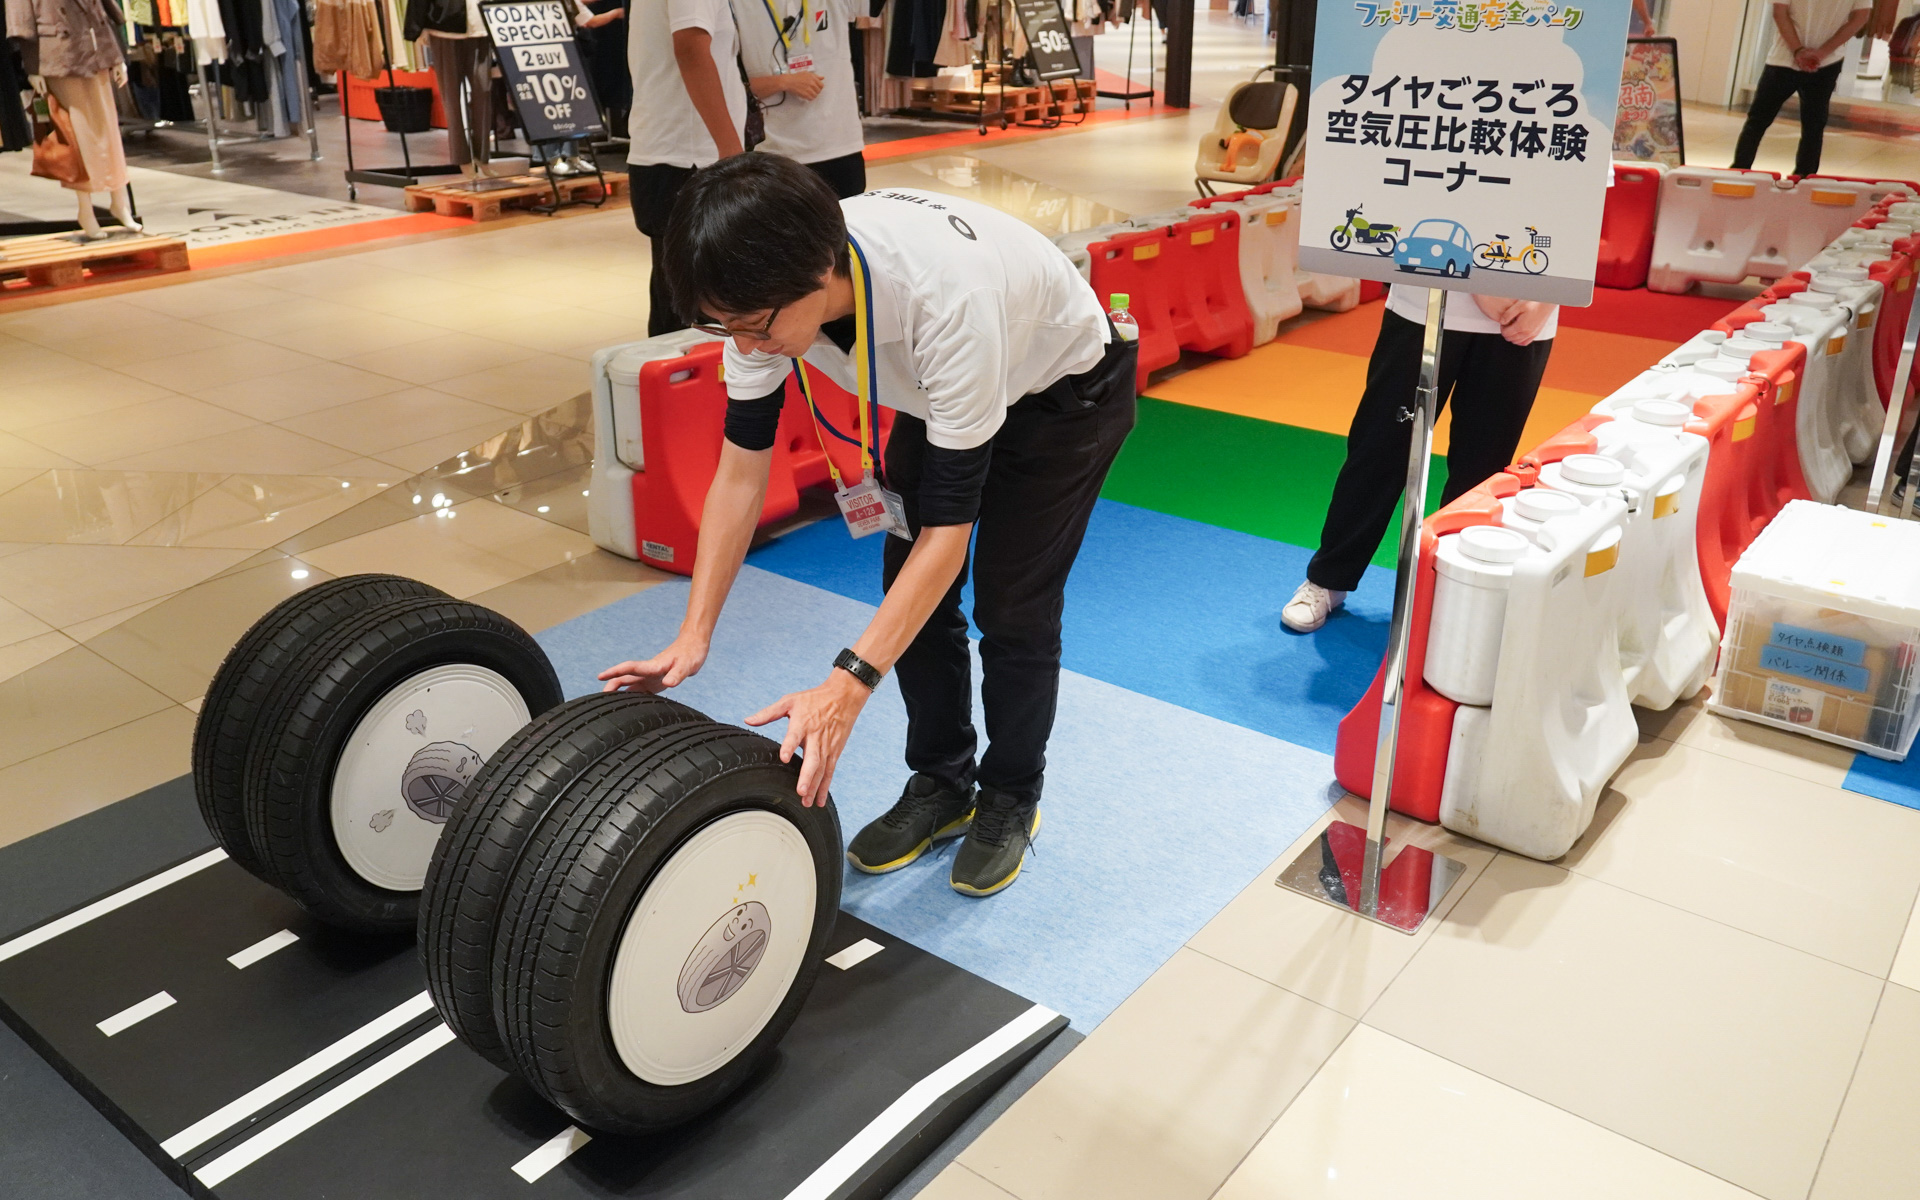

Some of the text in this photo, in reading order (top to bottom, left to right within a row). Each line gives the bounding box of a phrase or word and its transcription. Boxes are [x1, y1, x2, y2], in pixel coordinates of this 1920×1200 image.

[484, 4, 563, 24] TODAY'S
[1355, 0, 1582, 31] ファミリー交通安全パーク
[497, 22, 574, 42] SPECIAL
[522, 50, 562, 67] 2 BUY
[526, 72, 587, 104] 10%
[1341, 74, 1579, 118] タイヤごろごろ
[544, 103, 572, 120] OFF
[1622, 110, 1649, 120] まつり
[1325, 109, 1590, 162] 空気圧比較体験
[1383, 157, 1511, 193] コーナー
[881, 192, 929, 205] TIRE
[846, 494, 875, 509] VISITOR
[1778, 632, 1844, 657] タイヤ点検類
[1768, 657, 1847, 683] バルーン関係
